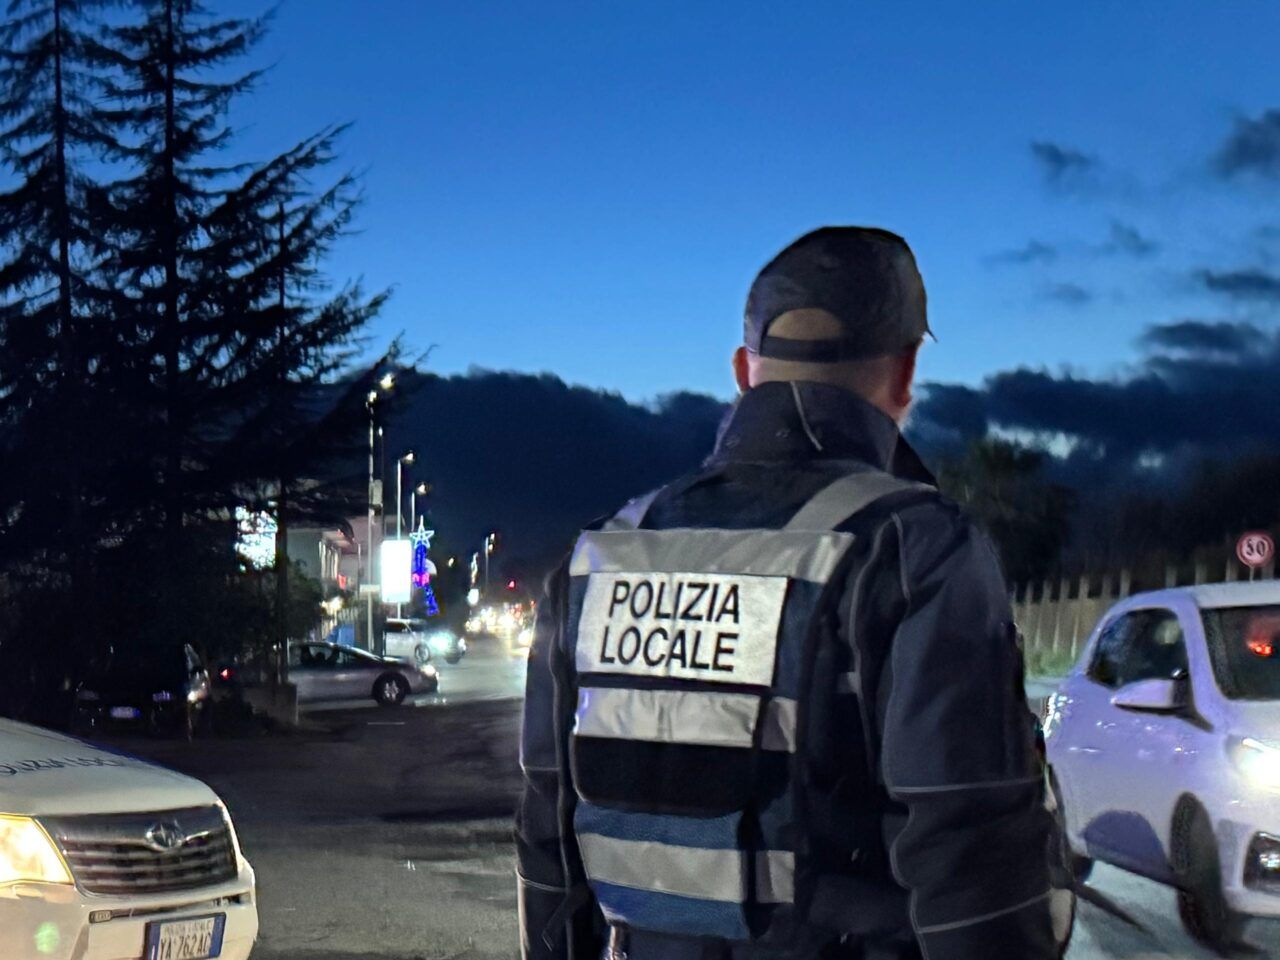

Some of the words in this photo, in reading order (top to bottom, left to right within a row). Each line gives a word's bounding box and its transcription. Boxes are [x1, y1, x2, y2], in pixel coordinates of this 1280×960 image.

[1246, 538, 1266, 557] 50
[608, 579, 740, 624] POLIZIA
[599, 625, 739, 672] LOCALE
